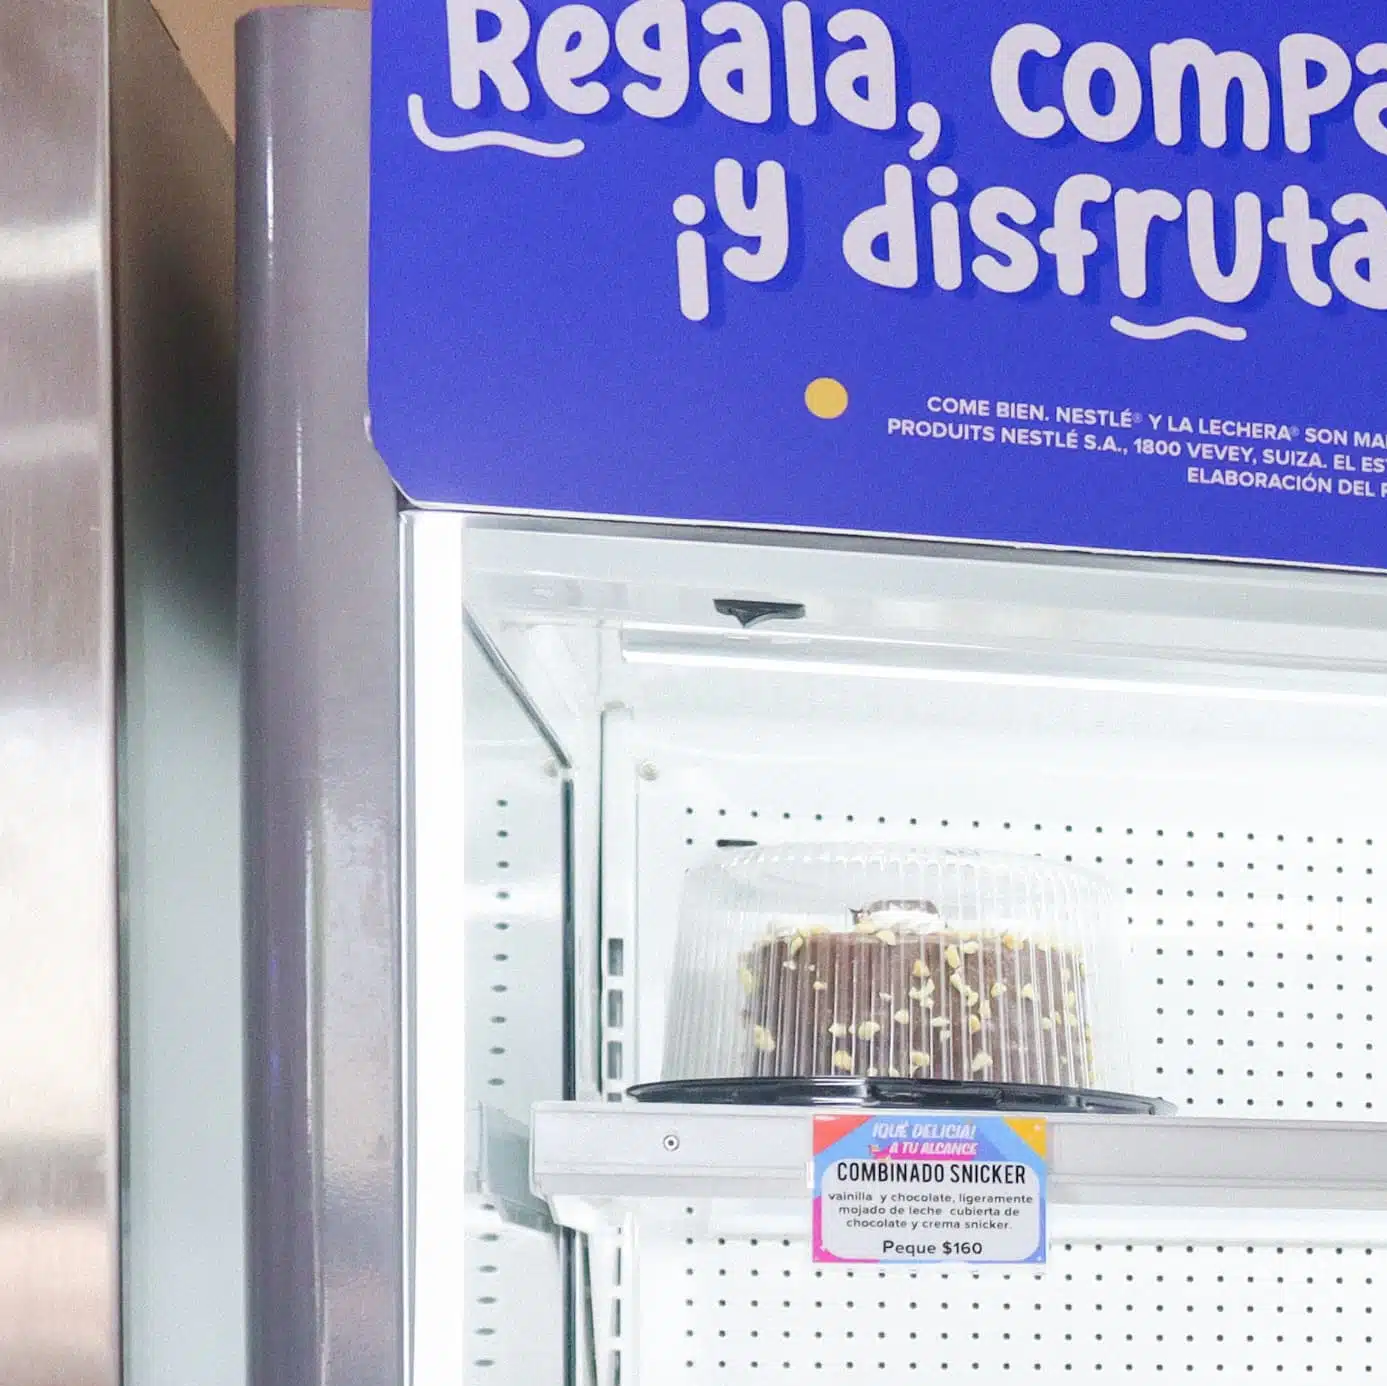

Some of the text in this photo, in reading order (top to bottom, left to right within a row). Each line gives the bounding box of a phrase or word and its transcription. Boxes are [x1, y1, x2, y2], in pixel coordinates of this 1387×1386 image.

[447, 0, 940, 161] Regala,
[927, 396, 990, 417] COME
[996, 403, 1049, 422] BIEN.
[1149, 414, 1163, 431] Y
[1167, 415, 1193, 434] LA
[1305, 428, 1347, 447] SON
[888, 417, 995, 443] PRODUITS
[1000, 426, 1078, 449] NESTLÉ
[1084, 434, 1129, 456] S.A.,
[1133, 438, 1181, 457] 1800
[1187, 441, 1258, 466] VEVEY,
[1262, 448, 1328, 471] SUIZA.
[1333, 453, 1356, 472] EL
[1187, 466, 1332, 493] ELABORACIÓN
[1338, 478, 1376, 498] DEL
[888, 1142, 977, 1156] A TU ALCANCE
[837, 1162, 1026, 1184] COMBINADO SNICKER
[828, 1192, 873, 1202] vainilla
[891, 1193, 956, 1204] chocolate,
[959, 1193, 1034, 1206] ligeramente
[838, 1206, 886, 1217] mojado
[889, 1206, 905, 1216] de
[949, 1207, 1001, 1218] cubierta
[1004, 1208, 1020, 1217] de
[846, 1218, 907, 1229] chocolate
[922, 1220, 960, 1230] crema
[882, 1240, 984, 1257] Peque $160
